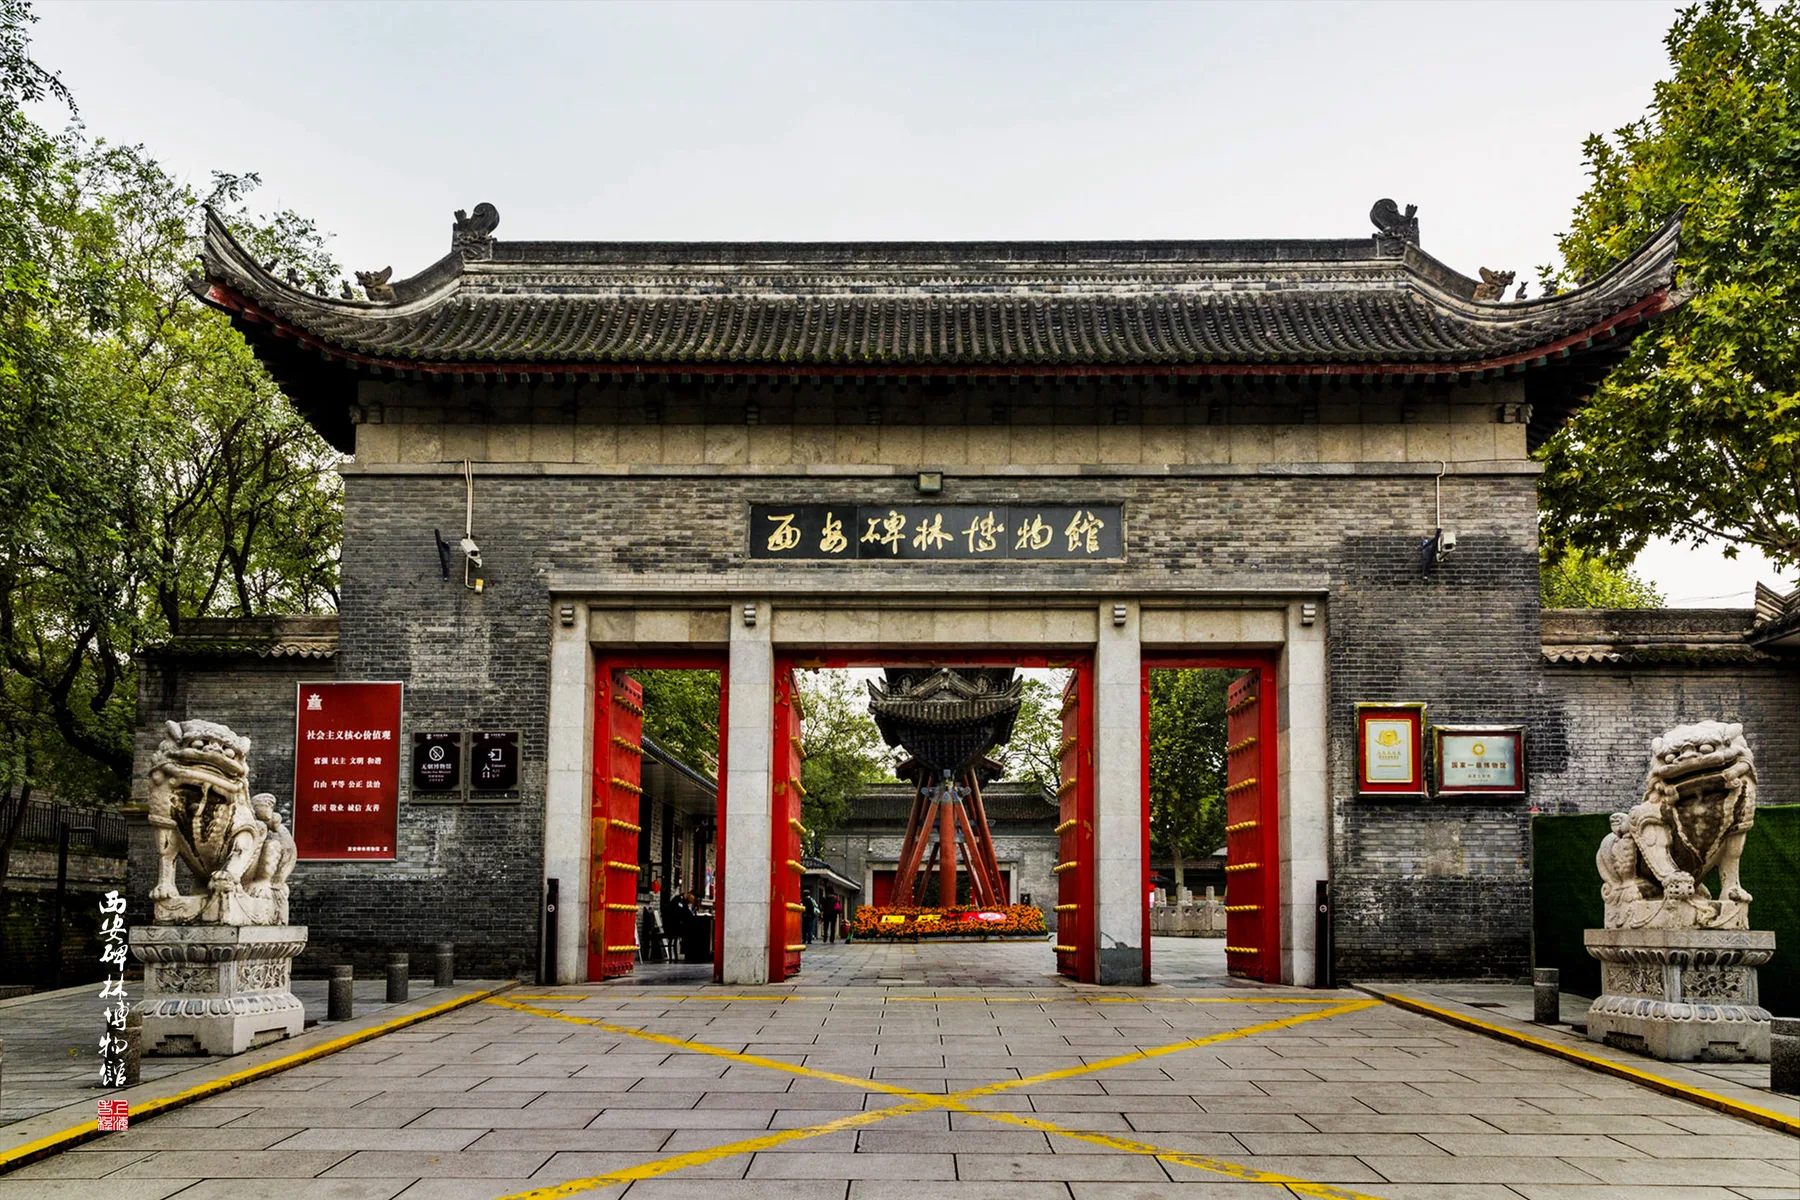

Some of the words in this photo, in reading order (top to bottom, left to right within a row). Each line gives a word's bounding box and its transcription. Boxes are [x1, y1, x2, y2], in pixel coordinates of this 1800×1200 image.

[306, 730, 392, 740] 社会主义核心价值观
[313, 757, 329, 765] 富强
[331, 757, 346, 765] 民主
[349, 757, 365, 765] 文明
[367, 757, 382, 765] 和谐
[482, 763, 490, 778] 入口
[313, 780, 327, 788] 自由
[331, 780, 345, 788] 平等
[348, 780, 363, 788] 公正
[366, 780, 381, 788] 法治
[312, 804, 327, 812] 爱国
[329, 804, 344, 812] 敬业
[347, 804, 362, 812] 诚信
[365, 804, 380, 812] 友善
